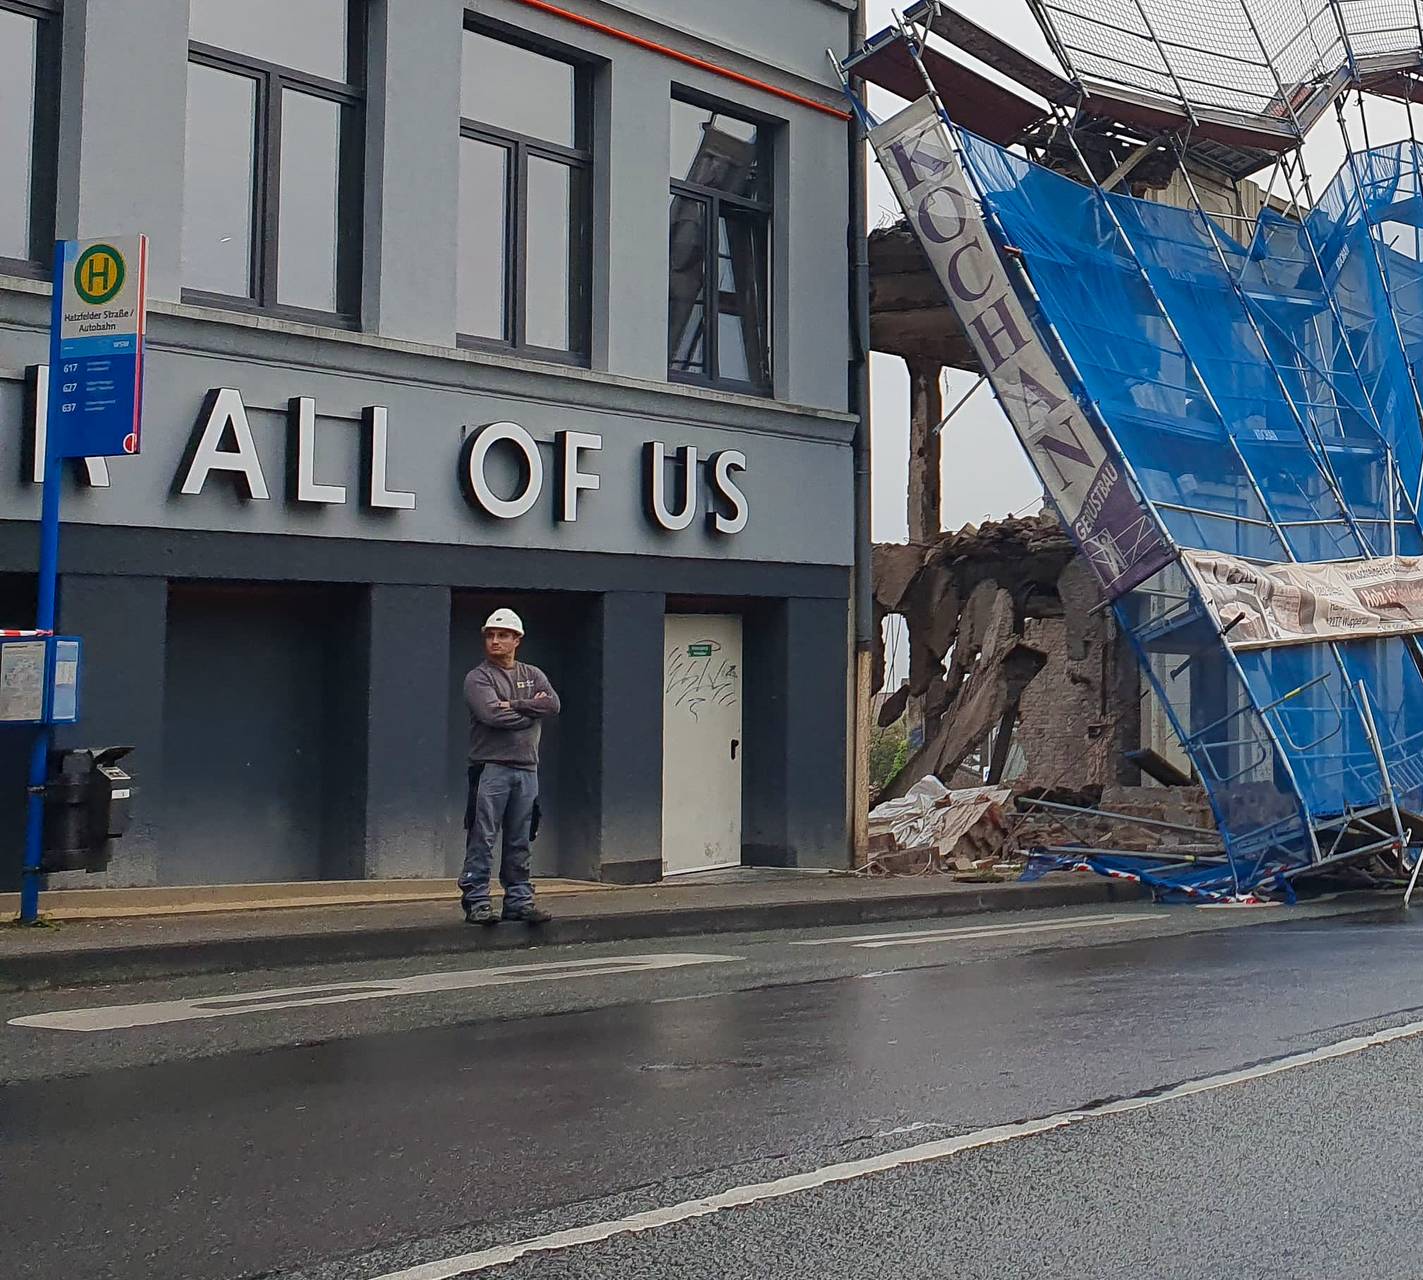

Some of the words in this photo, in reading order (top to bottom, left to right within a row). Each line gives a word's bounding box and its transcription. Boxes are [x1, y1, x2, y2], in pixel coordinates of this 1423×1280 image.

[87, 257, 111, 292] H
[103, 309, 129, 319] Straße
[888, 138, 1096, 492] KOCHAN
[79, 322, 116, 332] Autobahn
[63, 363, 78, 374] 617
[62, 403, 77, 413] 637
[178, 387, 416, 510] ALL
[464, 420, 602, 523] OF
[645, 440, 749, 535] US
